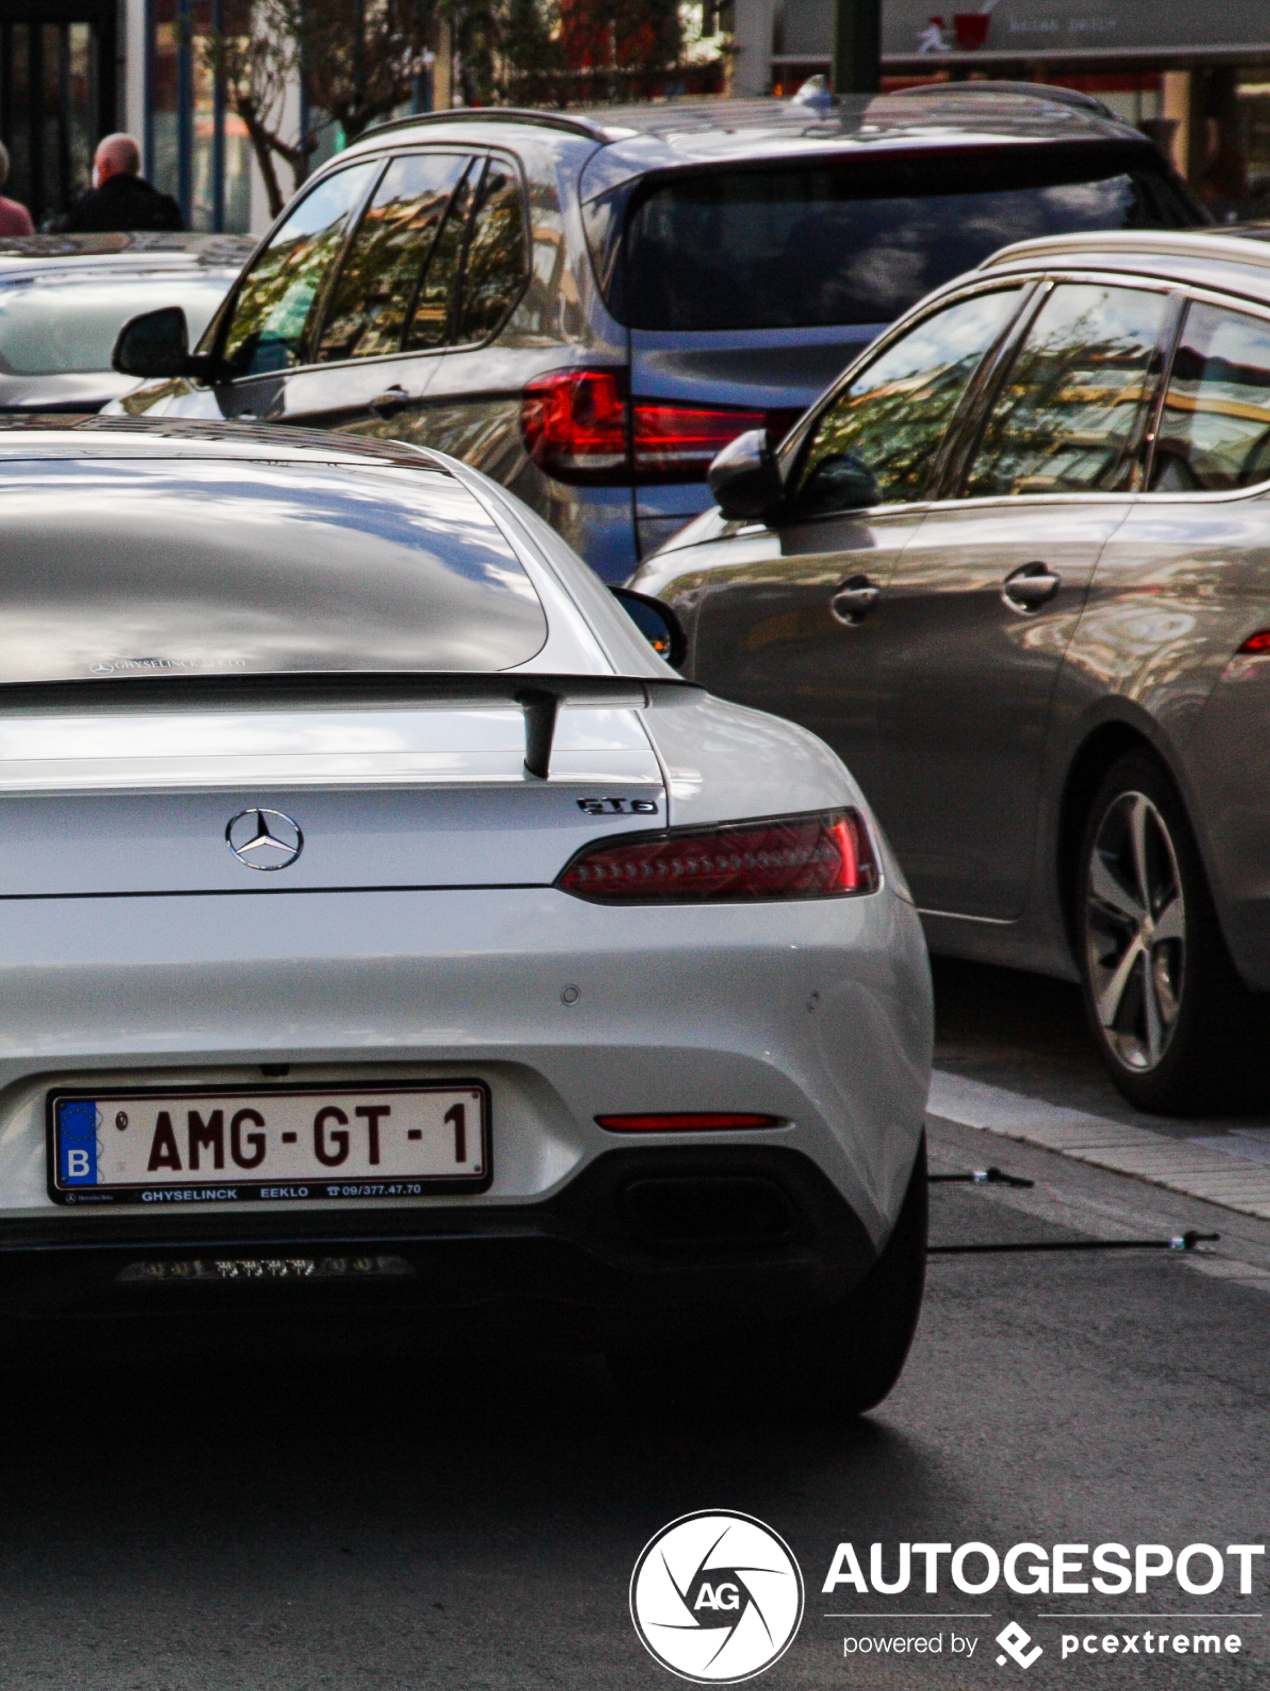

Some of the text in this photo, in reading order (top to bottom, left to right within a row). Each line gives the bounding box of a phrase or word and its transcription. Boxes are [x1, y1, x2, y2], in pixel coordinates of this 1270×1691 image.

[115, 659, 199, 670] GHYSELINCK
[67, 1149, 91, 1177] B
[141, 1184, 422, 1202] GHYSELINCK EEKLO 09/377.47.70
